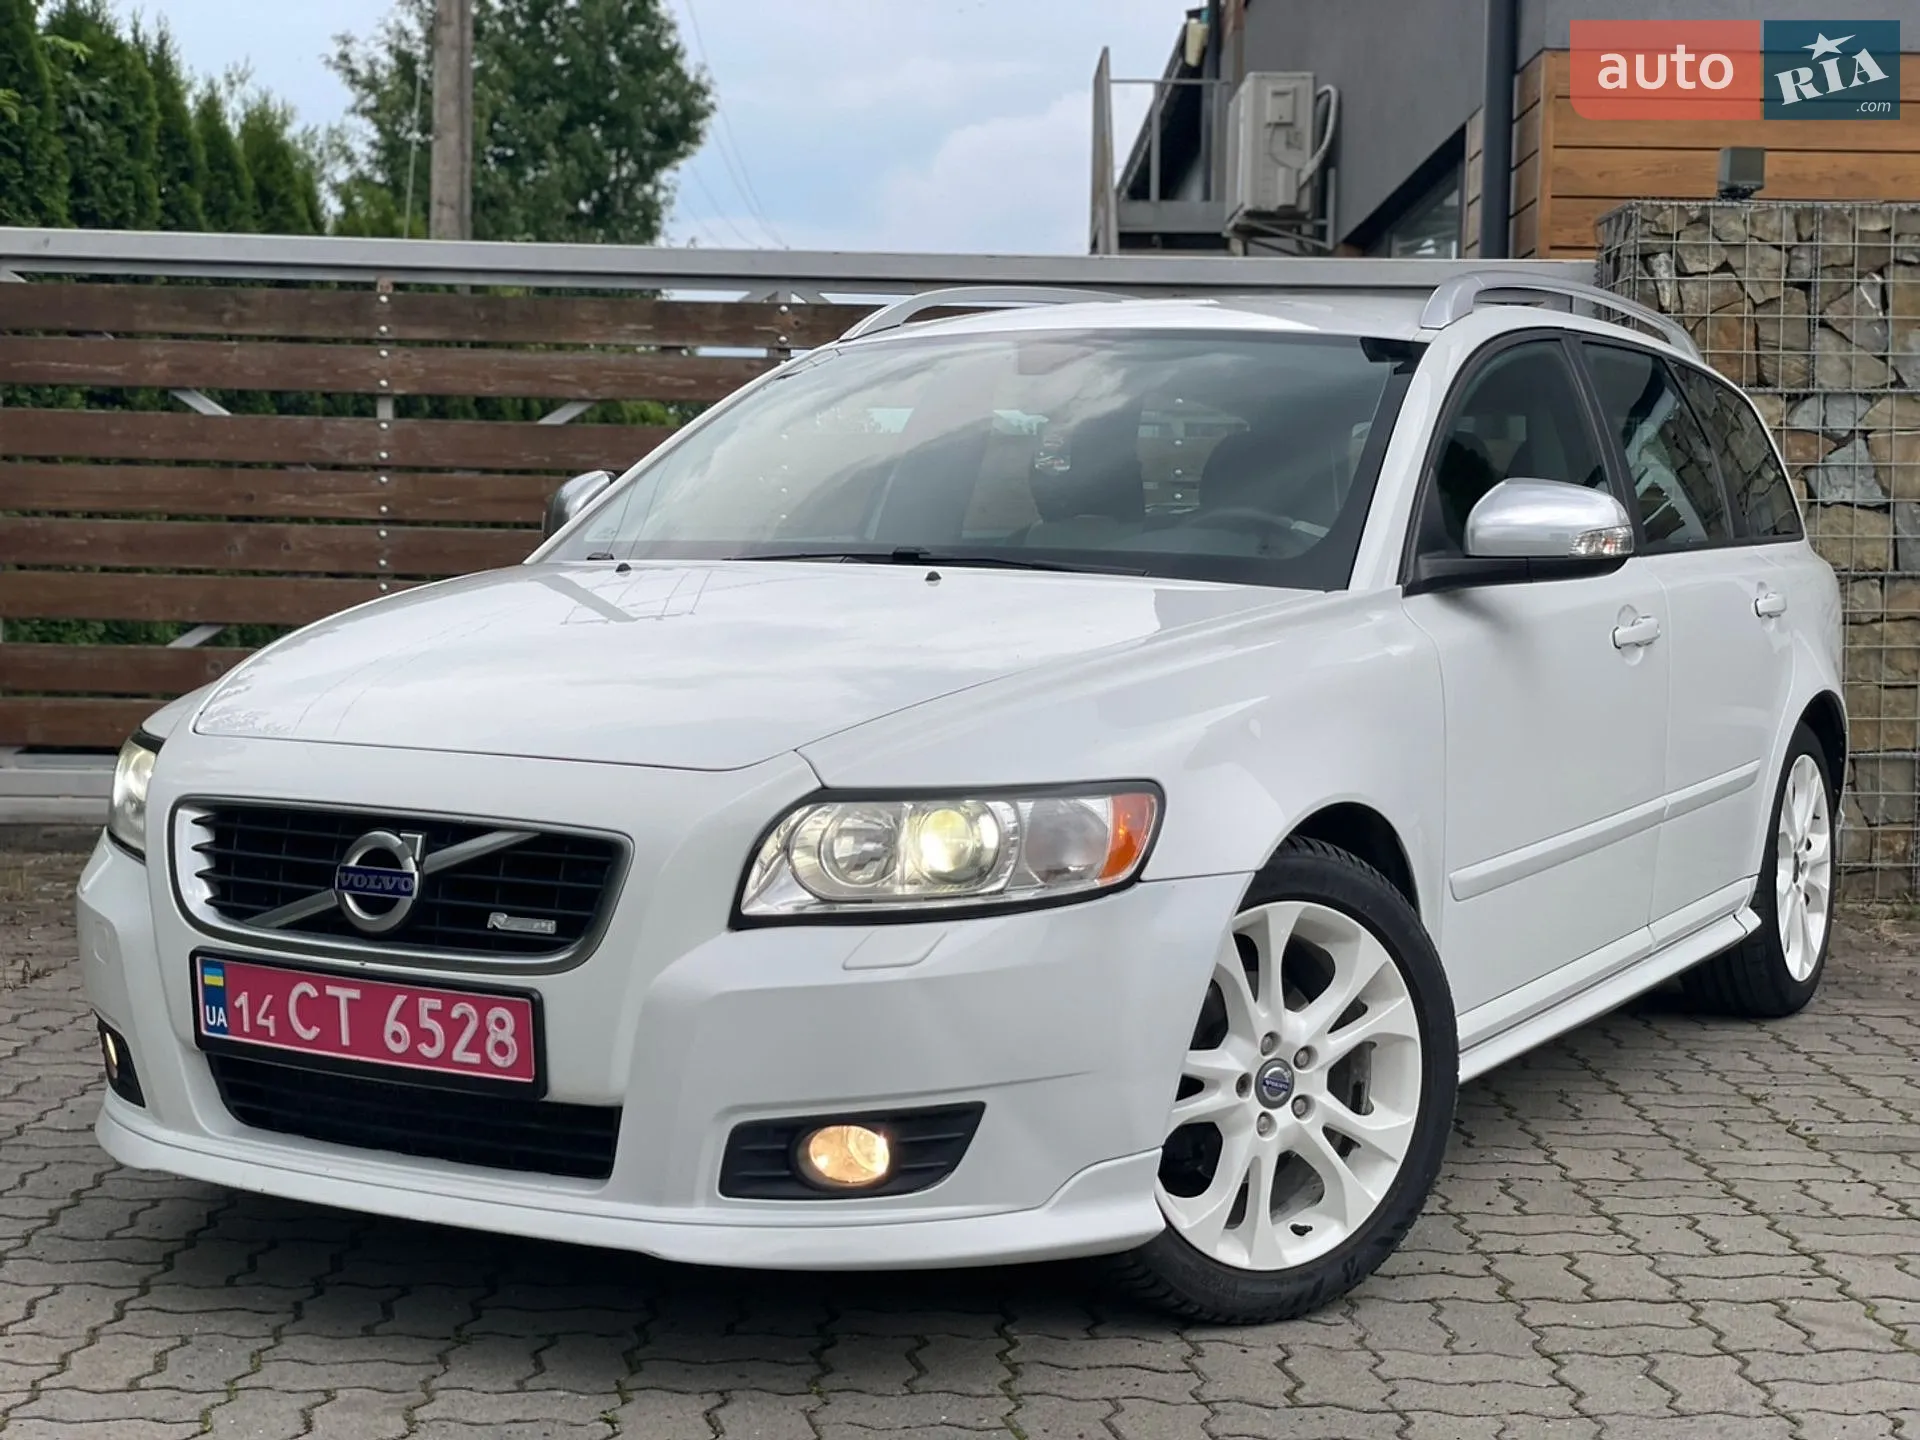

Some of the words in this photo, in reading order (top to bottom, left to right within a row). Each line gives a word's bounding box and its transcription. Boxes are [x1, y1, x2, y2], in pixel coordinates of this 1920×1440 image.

[339, 871, 415, 892] VOLVO
[205, 1004, 228, 1029] UA
[383, 994, 519, 1069] 6528
